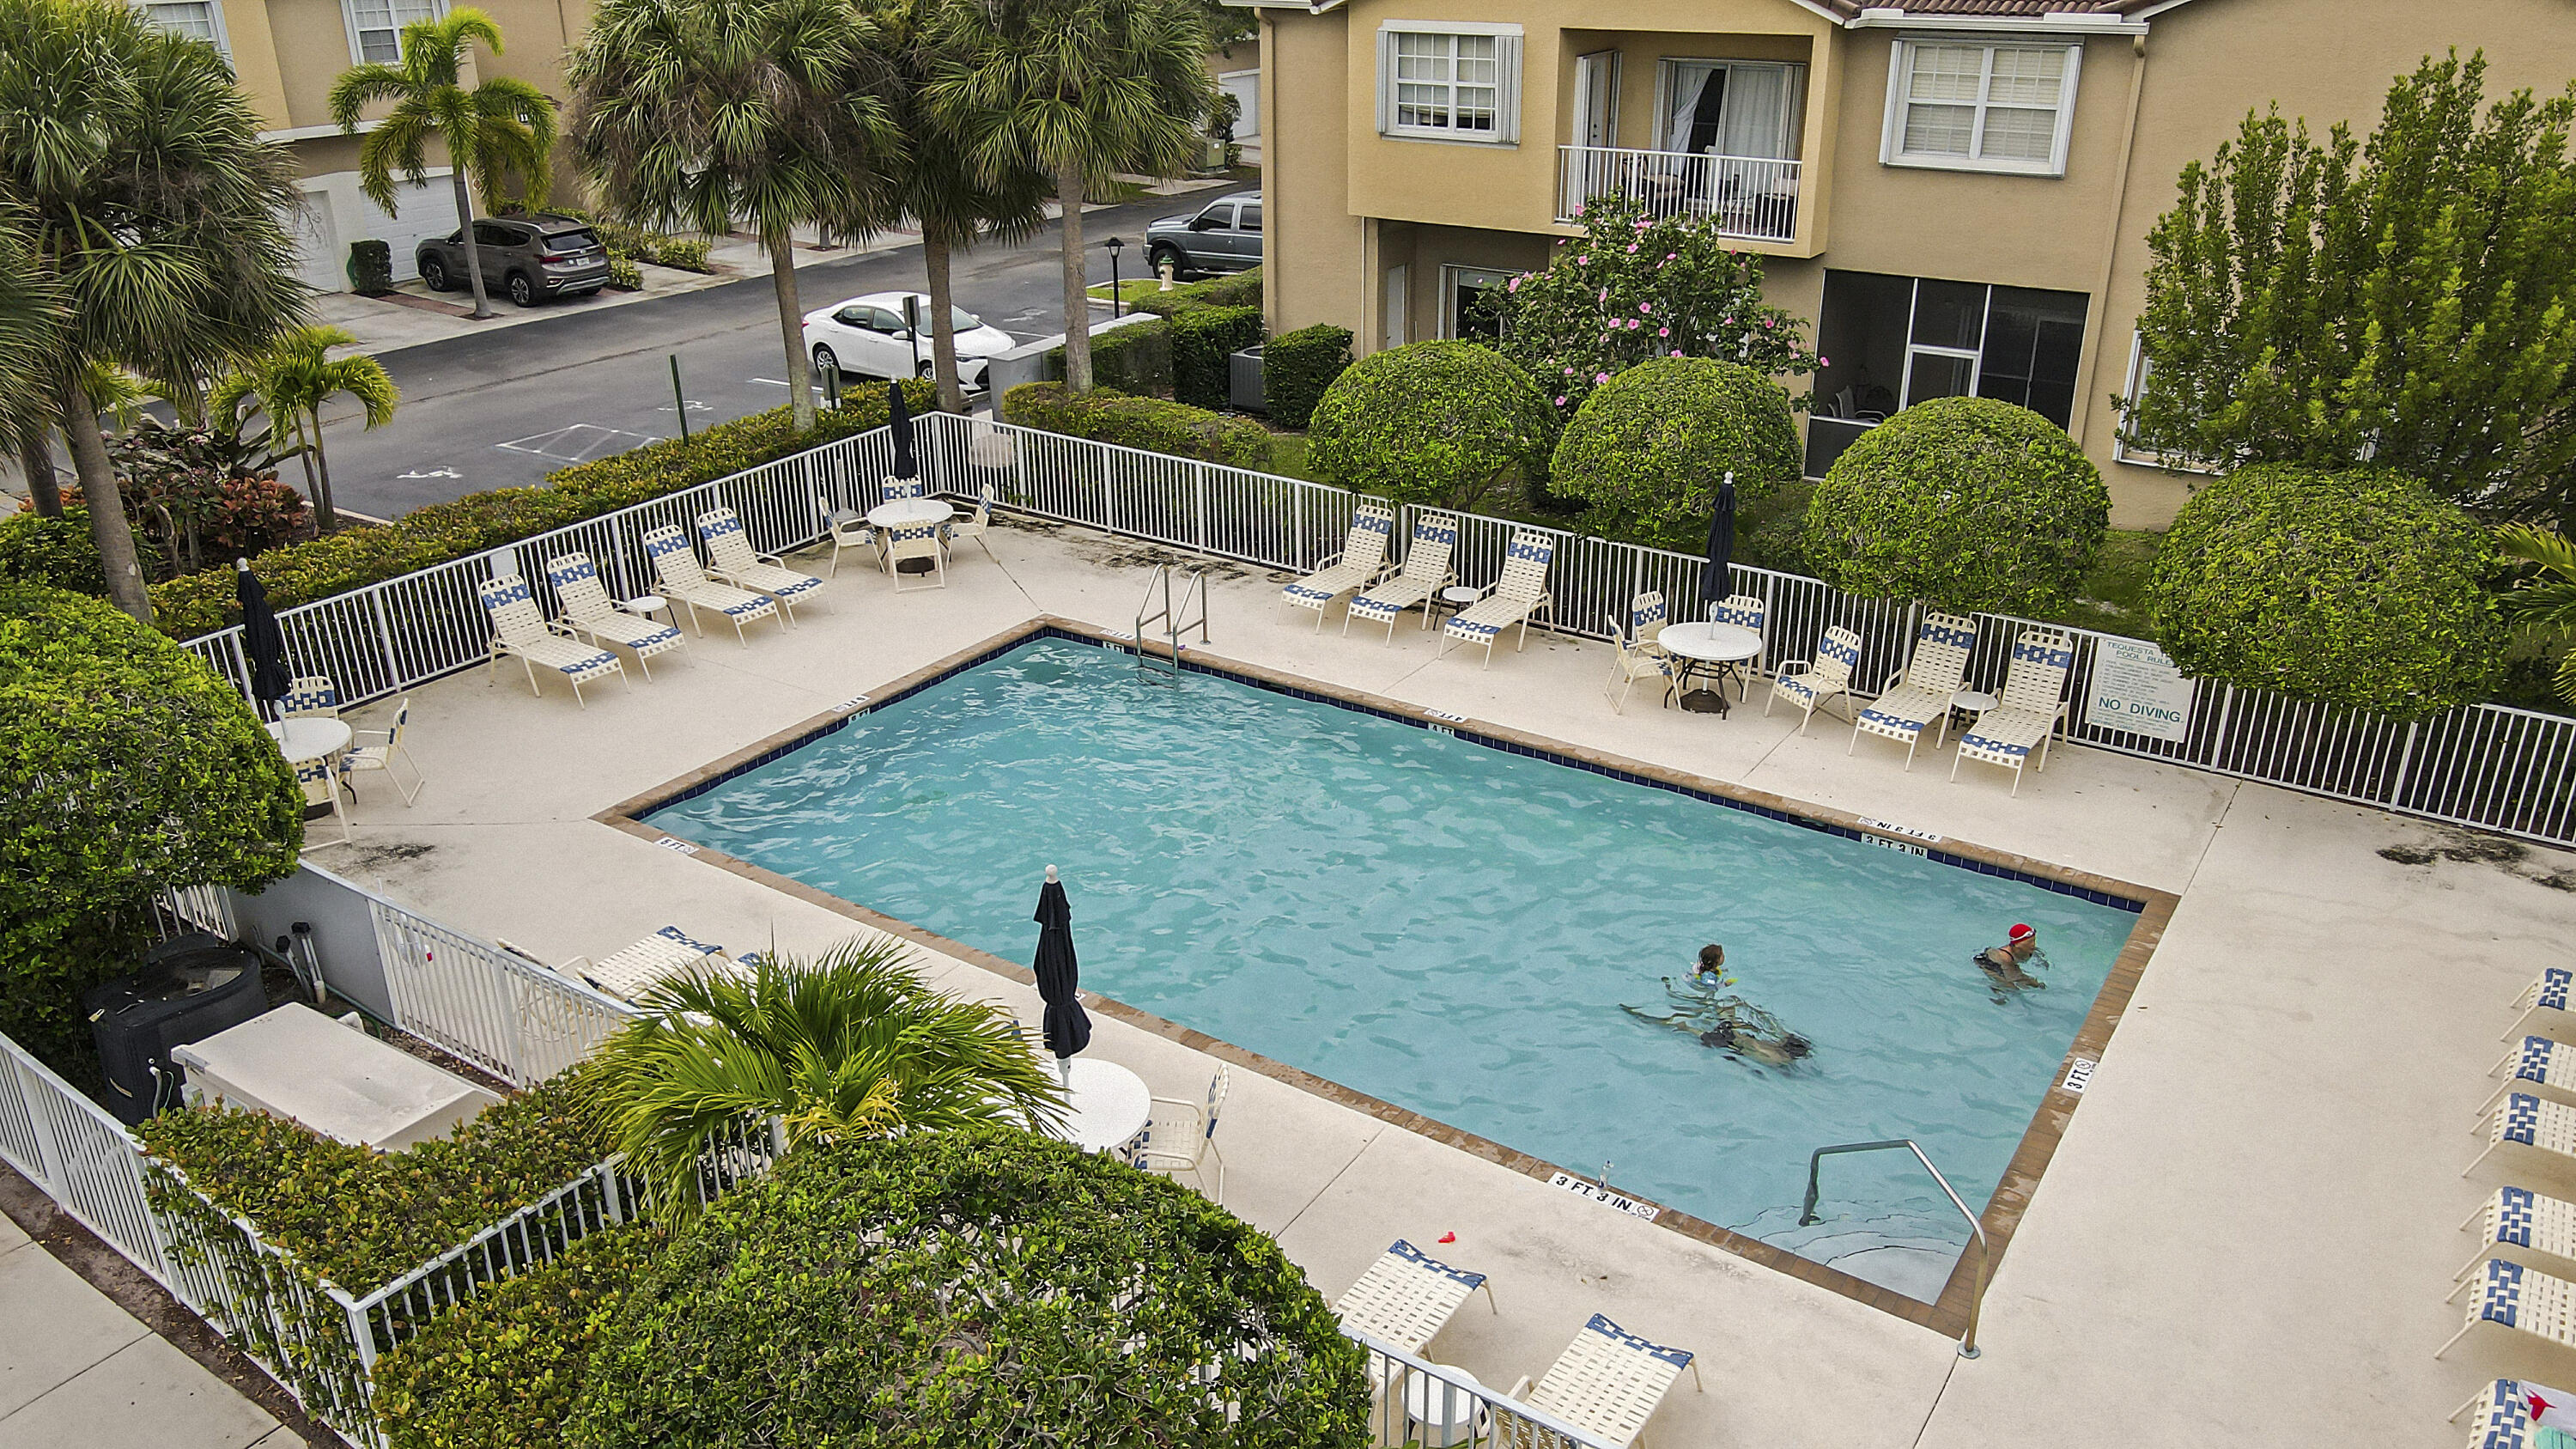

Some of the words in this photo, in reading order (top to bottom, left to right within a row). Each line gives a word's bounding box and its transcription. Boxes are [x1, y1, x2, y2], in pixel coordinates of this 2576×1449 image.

[2107, 641, 2154, 655] TEQUESTA
[2116, 650, 2142, 661] POOL
[2147, 655, 2173, 666] RULE
[2099, 697, 2121, 710] NO
[1556, 1176, 1569, 1186] 3
[1571, 1181, 1594, 1196] FT.
[1596, 1192, 1609, 1202] 3
[1611, 1196, 1632, 1212] IN.
